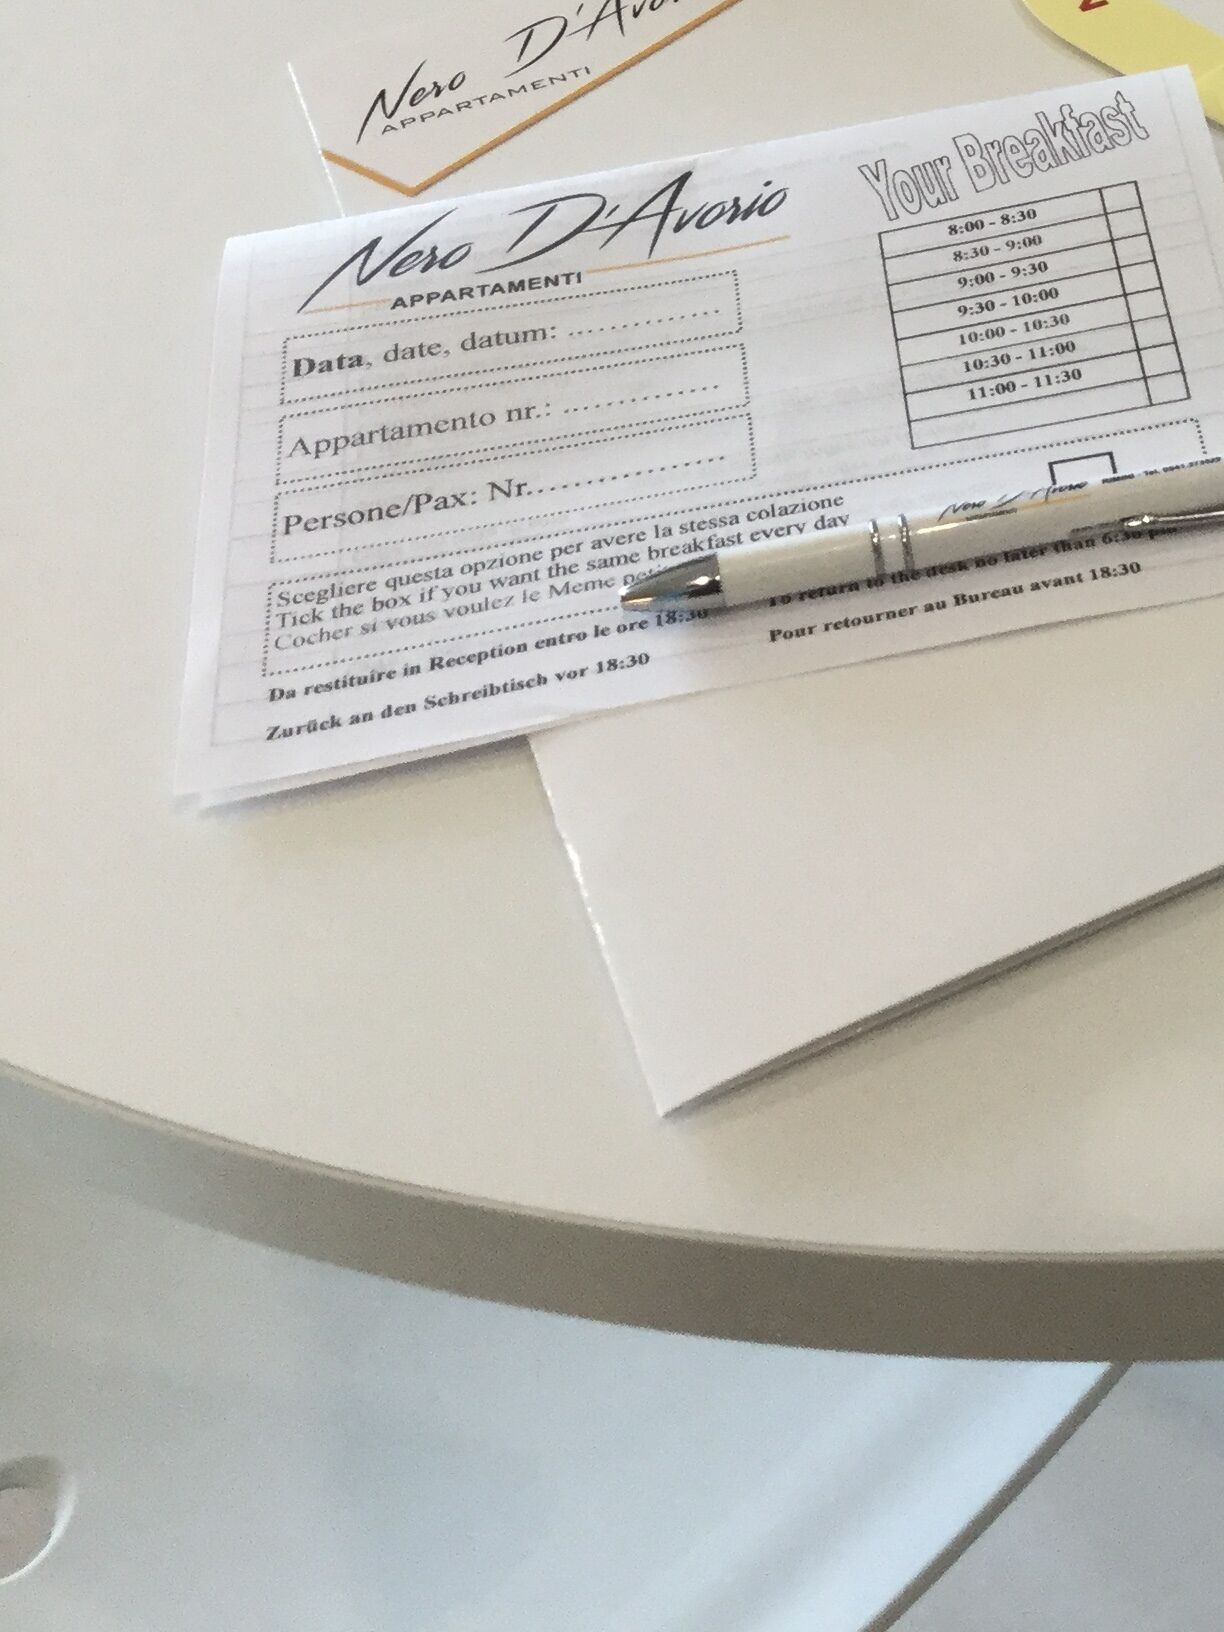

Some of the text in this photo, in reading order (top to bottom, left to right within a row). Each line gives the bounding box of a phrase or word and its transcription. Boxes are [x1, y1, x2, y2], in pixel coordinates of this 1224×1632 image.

[356, 58, 468, 145] Nero
[381, 65, 591, 136] APPARTAMENTI
[858, 90, 1150, 221] Your Breakfast
[296, 170, 790, 314] Nero D'Avorio
[947, 218, 985, 236] 8:00
[1000, 208, 1038, 226] 8:30
[953, 244, 990, 262] 8:30
[1005, 234, 1043, 251] 9:00
[390, 271, 584, 311] APPARTAMENTI
[957, 271, 996, 289] 9:00
[1010, 260, 1049, 278] 9:30
[957, 299, 996, 317] 9:30
[1012, 286, 1060, 307] 10:00
[292, 325, 557, 378] Data, date, datum:
[959, 325, 1006, 346] 10:00
[1023, 313, 1071, 333] 10:30
[963, 352, 1012, 373] 10:30
[1028, 340, 1076, 361] 11:00
[967, 380, 1017, 401] 11:00
[1034, 368, 1083, 389] 11:30
[287, 410, 497, 459] Appartamento
[283, 491, 478, 535] Persone/Pax:
[275, 512, 850, 629] Tick the box if you want the same breakfast every day
[276, 494, 844, 609] Scegliere questa opzione per avere la stessa colazione
[798, 581, 860, 602] return
[890, 570, 922, 585] the
[975, 555, 999, 569] no
[1003, 544, 1048, 564] later
[1052, 537, 1096, 554] than
[274, 624, 354, 652] Cocher
[359, 622, 378, 636] si
[384, 610, 437, 630] vous
[443, 593, 515, 619] voulez
[521, 588, 541, 604] le
[548, 575, 617, 599] Meme
[769, 560, 1142, 643] Pour retourner au Bureau avant 18:30
[267, 686, 297, 703] Da
[303, 668, 397, 696] restituire
[402, 663, 422, 678] in
[428, 639, 529, 672] Reception
[534, 630, 588, 651] entro
[593, 624, 611, 639] le
[616, 617, 649, 634] ore
[265, 651, 650, 742] Zurück an den Schreibtisch vor 18:30
